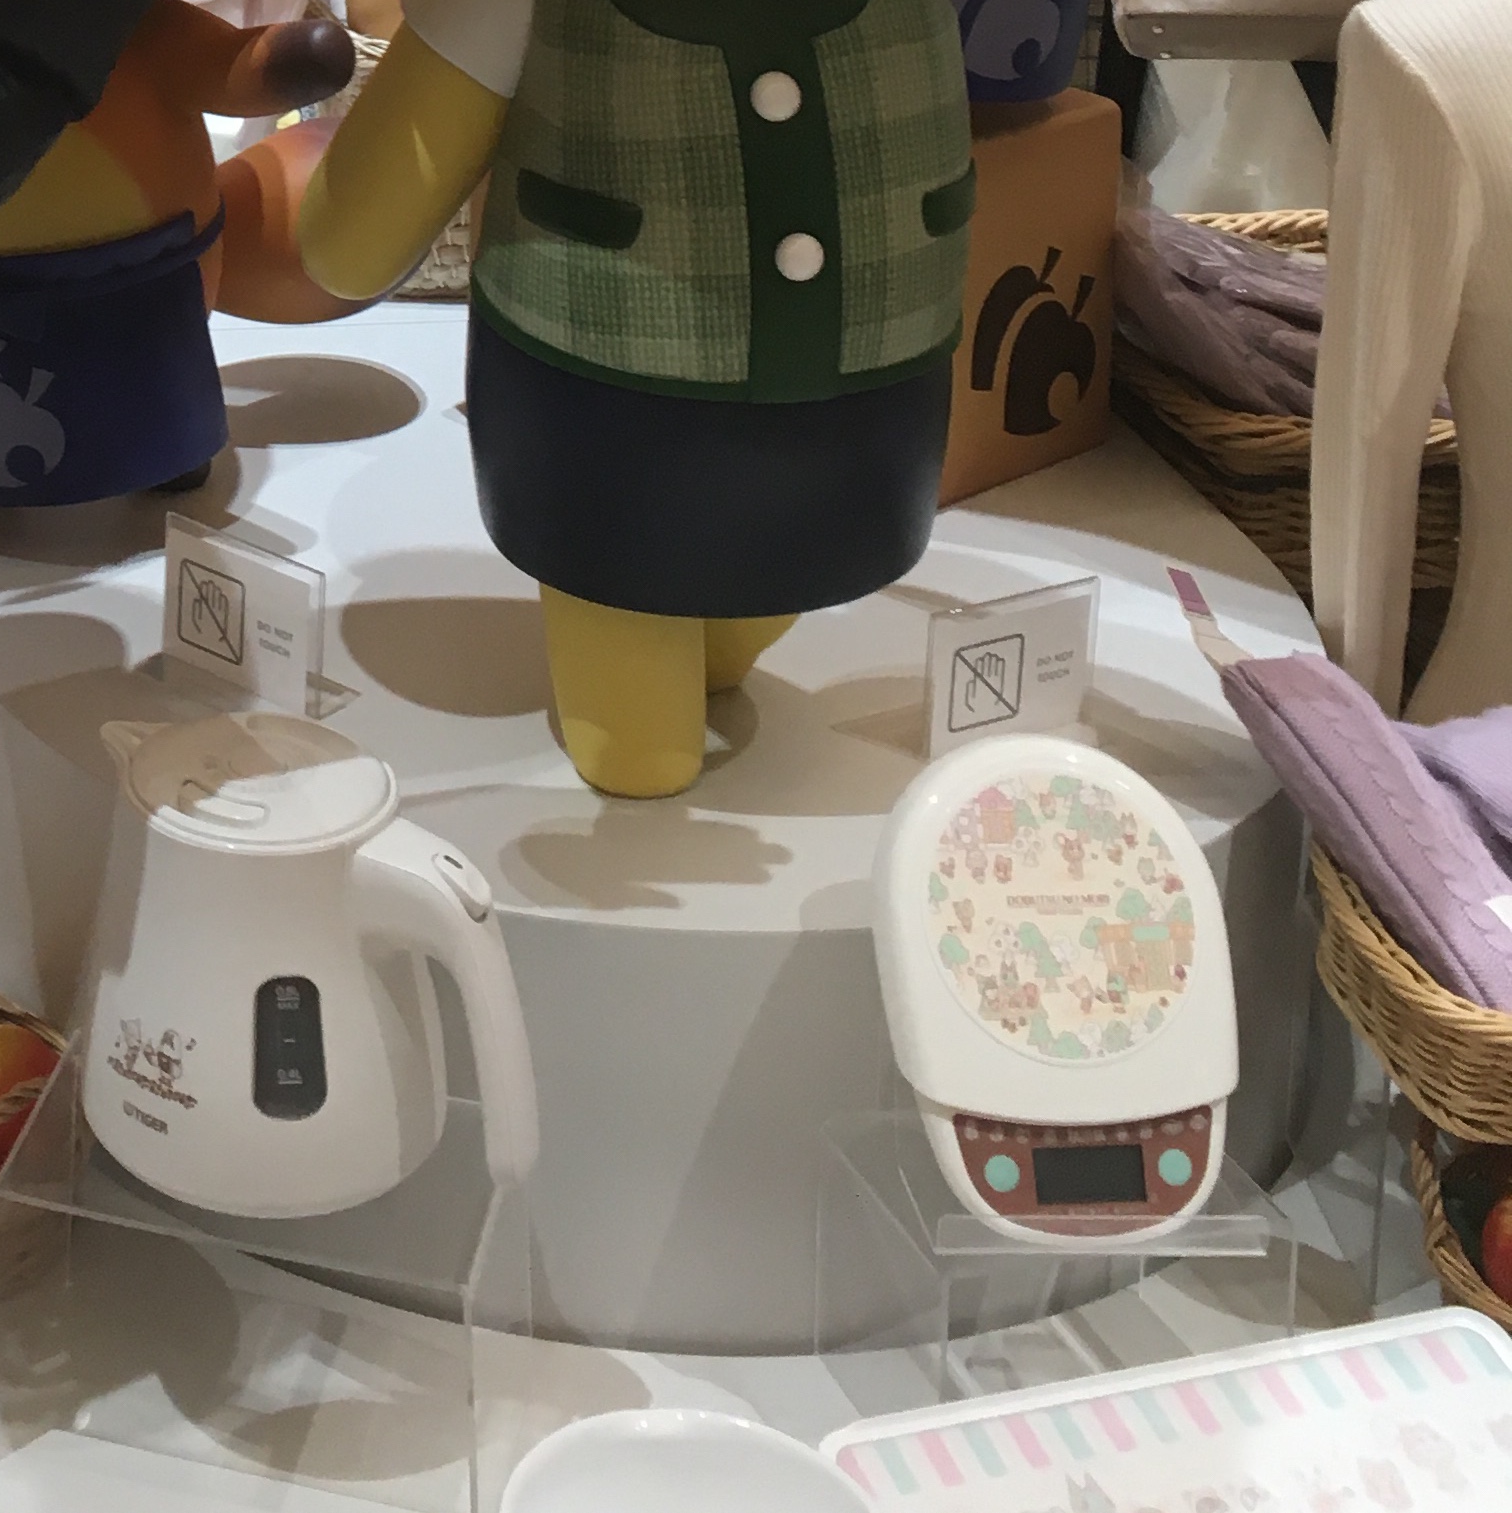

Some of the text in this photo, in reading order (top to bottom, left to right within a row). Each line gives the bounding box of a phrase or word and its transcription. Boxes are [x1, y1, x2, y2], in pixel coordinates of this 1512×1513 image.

[256, 619, 294, 643] DO NOT
[259, 637, 291, 658] TOUCH
[135, 1108, 169, 1136] TIGER
